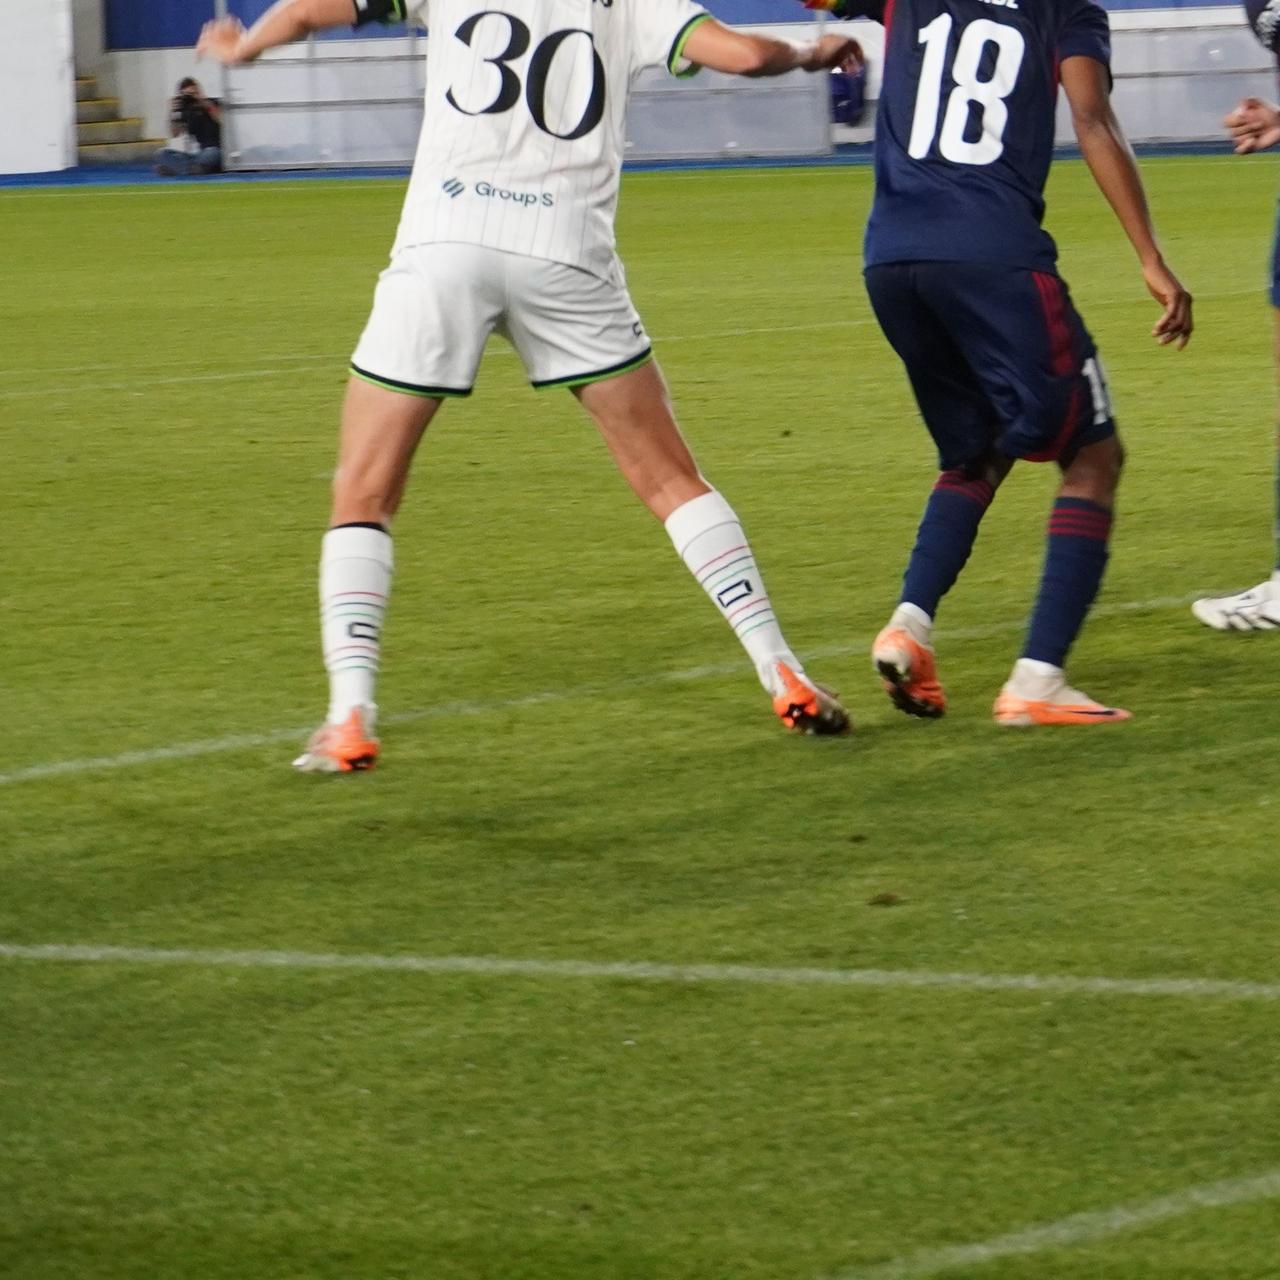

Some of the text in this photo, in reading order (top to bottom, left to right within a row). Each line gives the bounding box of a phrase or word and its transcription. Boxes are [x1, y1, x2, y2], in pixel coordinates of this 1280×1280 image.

[445, 11, 606, 140] 30
[908, 12, 1025, 165] 18
[475, 181, 554, 207] Group S
